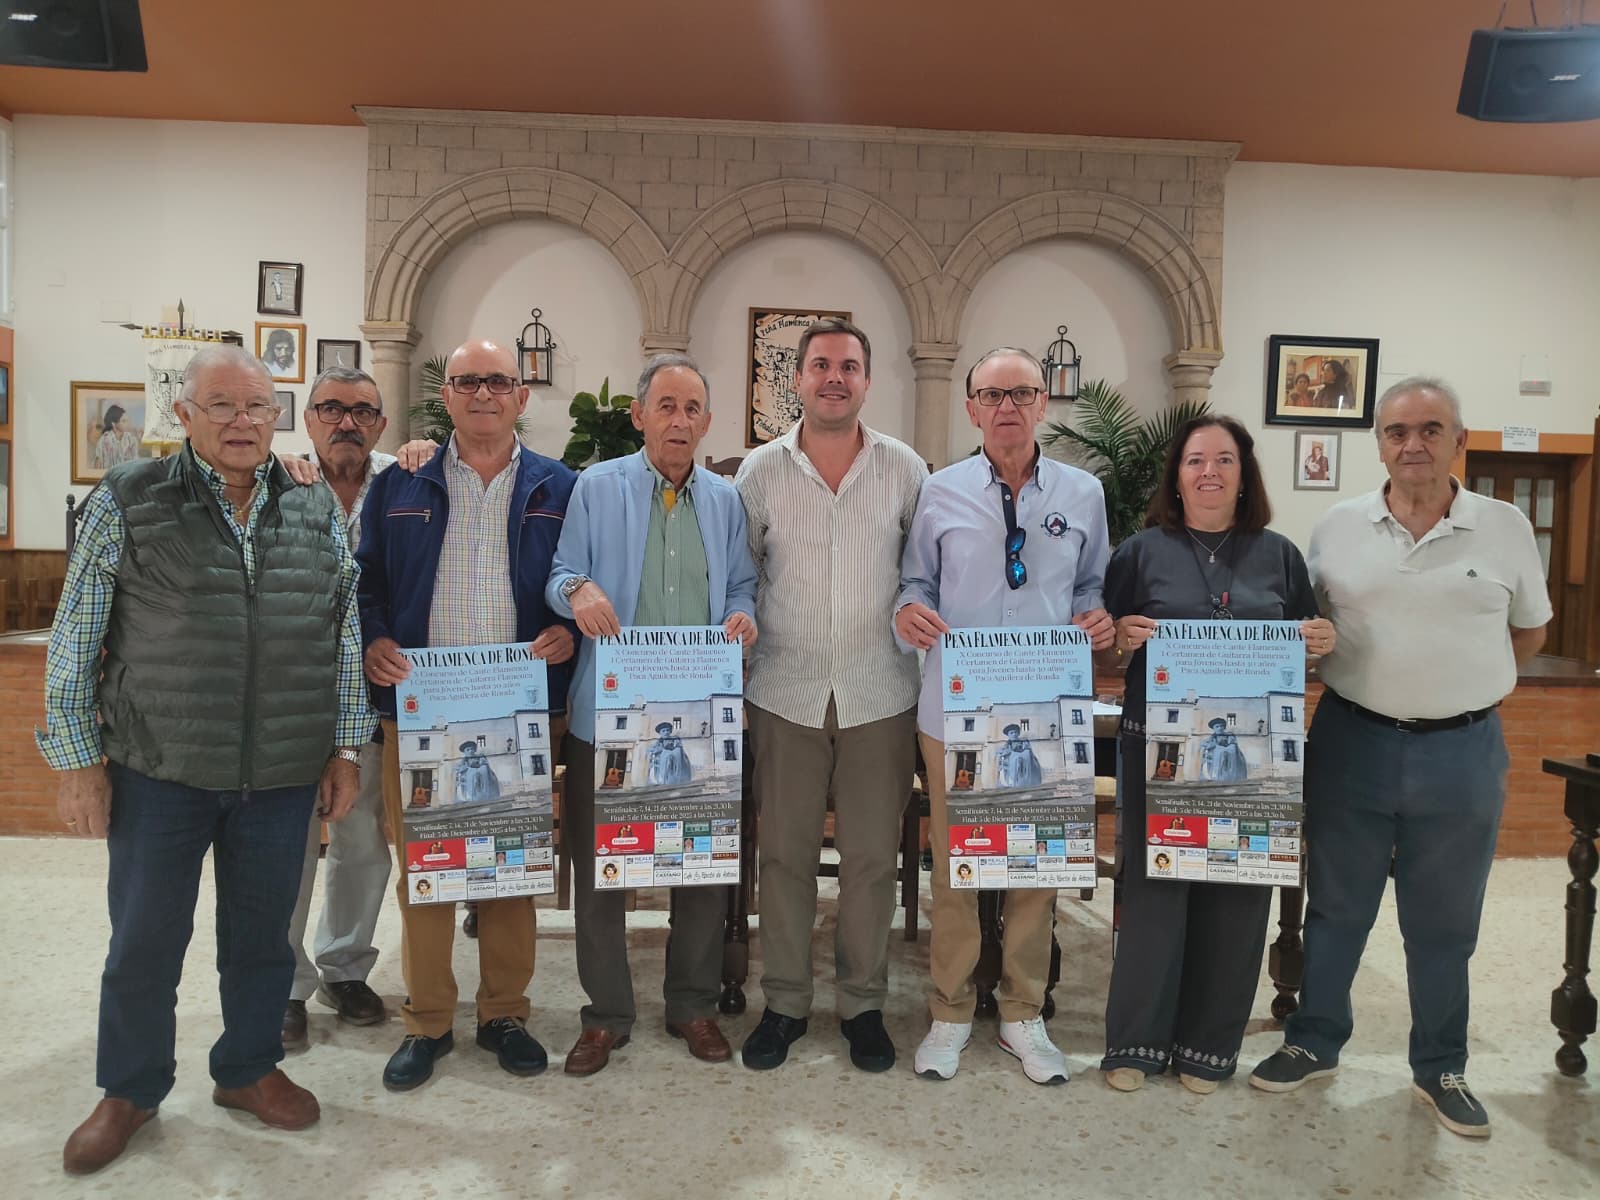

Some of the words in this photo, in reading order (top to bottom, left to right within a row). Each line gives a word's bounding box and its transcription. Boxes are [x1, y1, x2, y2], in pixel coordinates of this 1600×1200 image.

[630, 629, 687, 646] FLAMENCA
[689, 632, 703, 645] DE
[944, 631, 972, 648] PEÑA
[974, 630, 1032, 648] FLAMENCA
[1034, 632, 1048, 646] DE
[1051, 628, 1088, 646] RONDA
[1182, 623, 1242, 640] FLAMENCA
[1245, 626, 1260, 641] DE
[428, 648, 486, 668] FLAMENCA
[488, 649, 503, 664] DE
